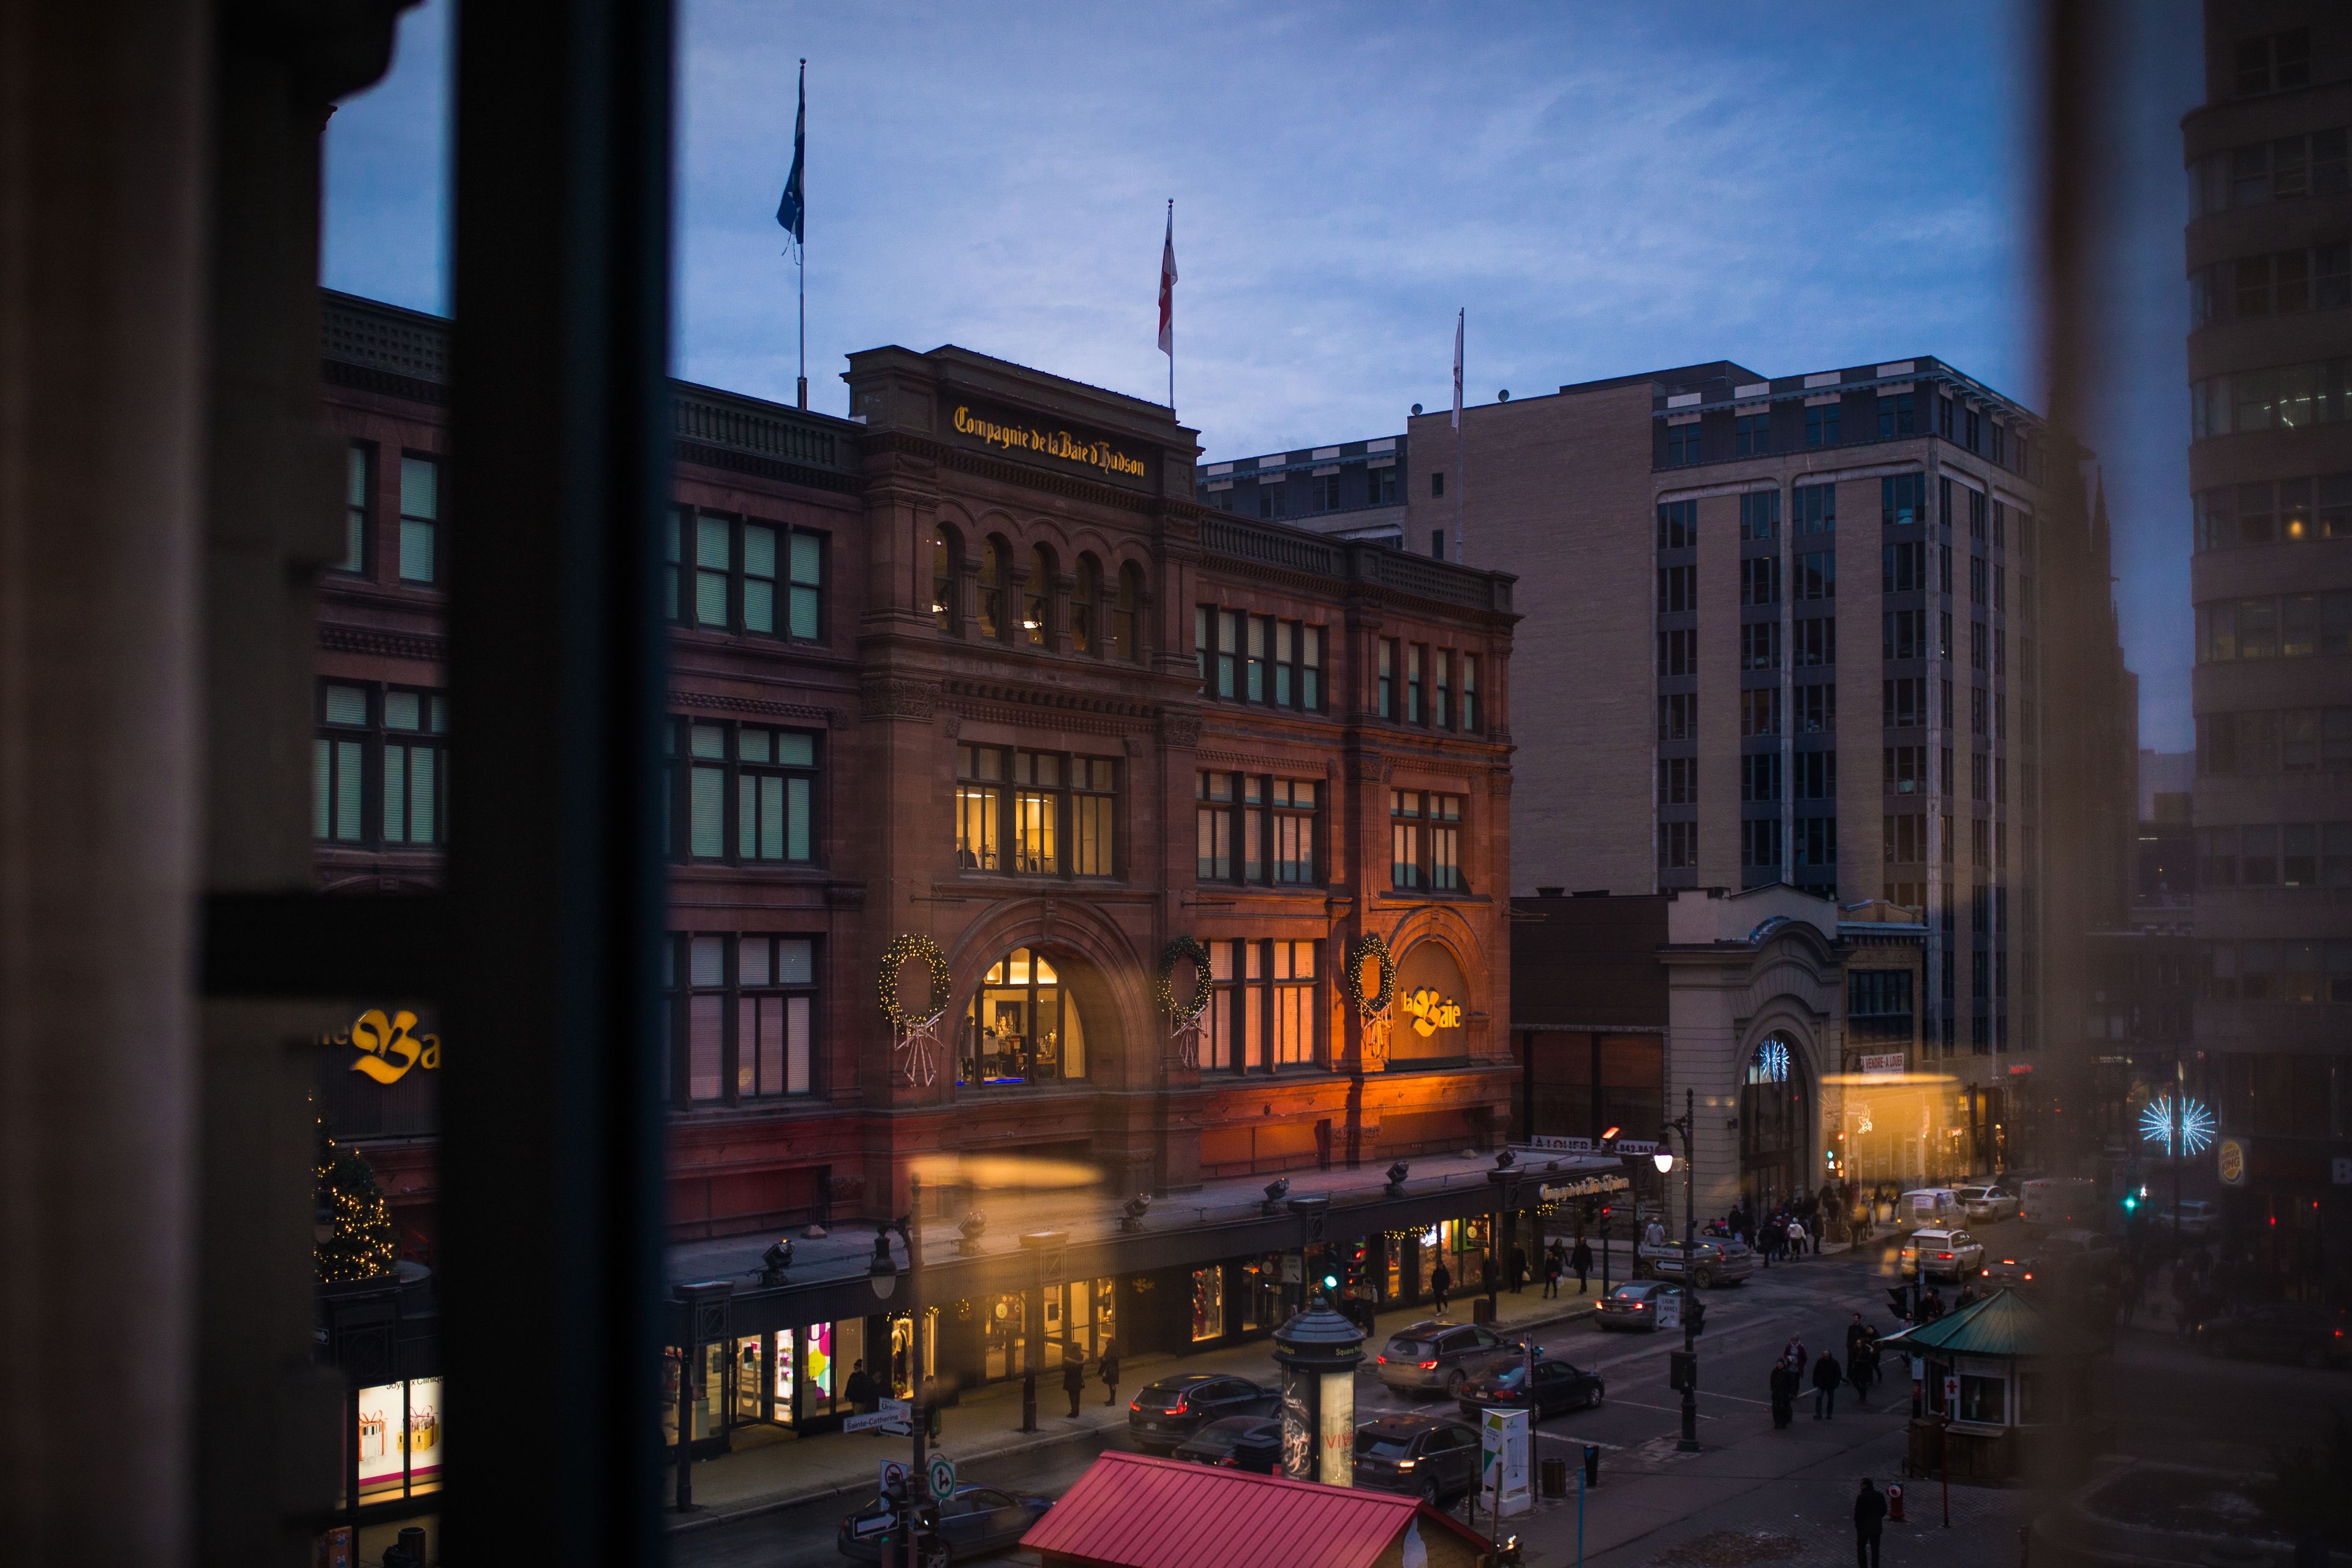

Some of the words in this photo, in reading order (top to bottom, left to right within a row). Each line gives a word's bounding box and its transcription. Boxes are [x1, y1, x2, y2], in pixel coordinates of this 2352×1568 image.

[954, 405, 1028, 449] Compagnie
[1031, 429, 1046, 451] de
[1048, 432, 1059, 455] la
[1058, 431, 1088, 462] Baie
[1090, 440, 1145, 477] d'Hudson
[1401, 991, 1413, 1012] la
[349, 1009, 441, 1084] Ba
[2222, 1157, 2241, 1172] KING
[417, 1376, 445, 1385] Cliniqu
[847, 1415, 899, 1430] Sainte-Catherine
